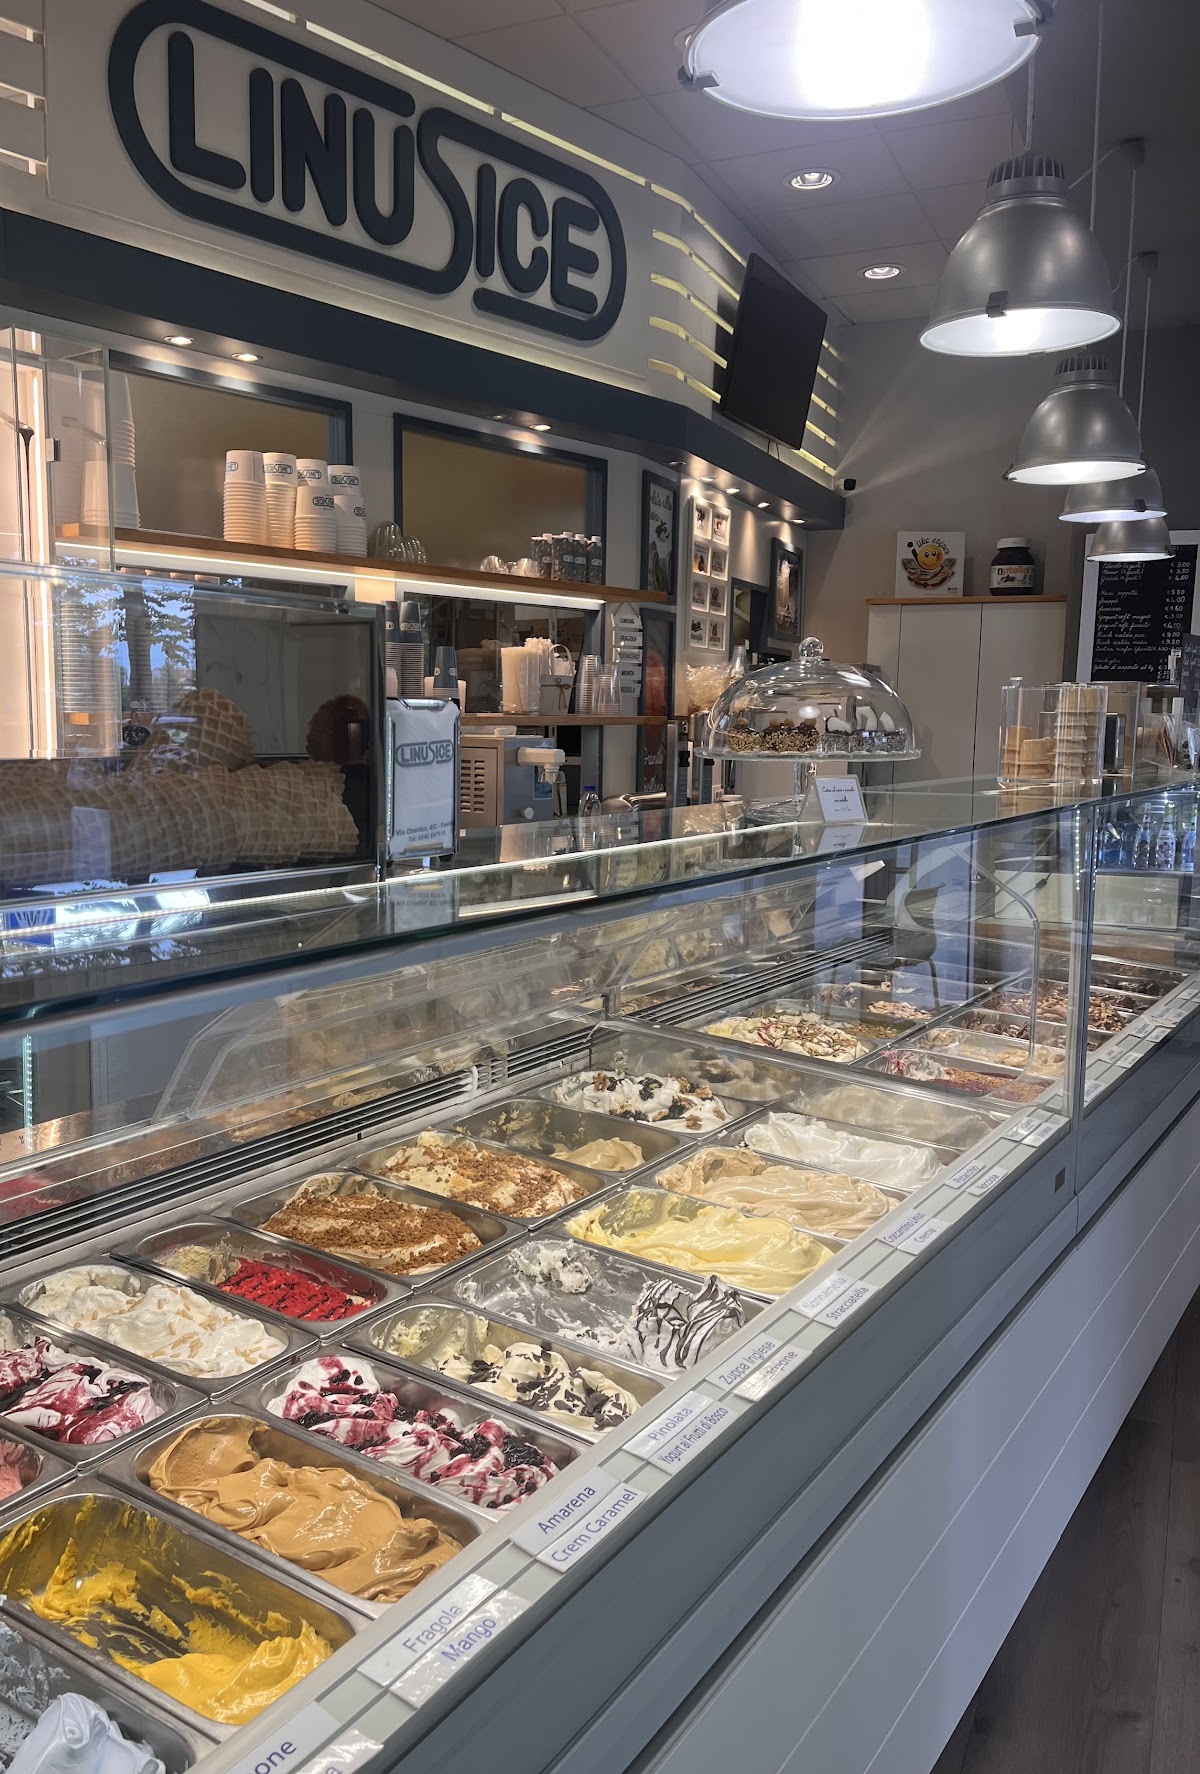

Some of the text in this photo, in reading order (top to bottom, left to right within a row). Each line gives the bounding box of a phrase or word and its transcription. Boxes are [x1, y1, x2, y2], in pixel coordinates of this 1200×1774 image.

[997, 567, 1030, 576] nutella
[914, 1228, 937, 1243] Crema
[826, 1286, 870, 1320] Stracciatella
[718, 1341, 776, 1385] Zuppa Inglese
[647, 1407, 694, 1441] Pinolata
[658, 1407, 729, 1465] Yogurt ai Frutti di Bosco
[539, 1485, 596, 1534] Amarena
[551, 1488, 639, 1563] Crem Caramel
[402, 1604, 462, 1654] Fragola
[441, 1616, 497, 1663] Mango
